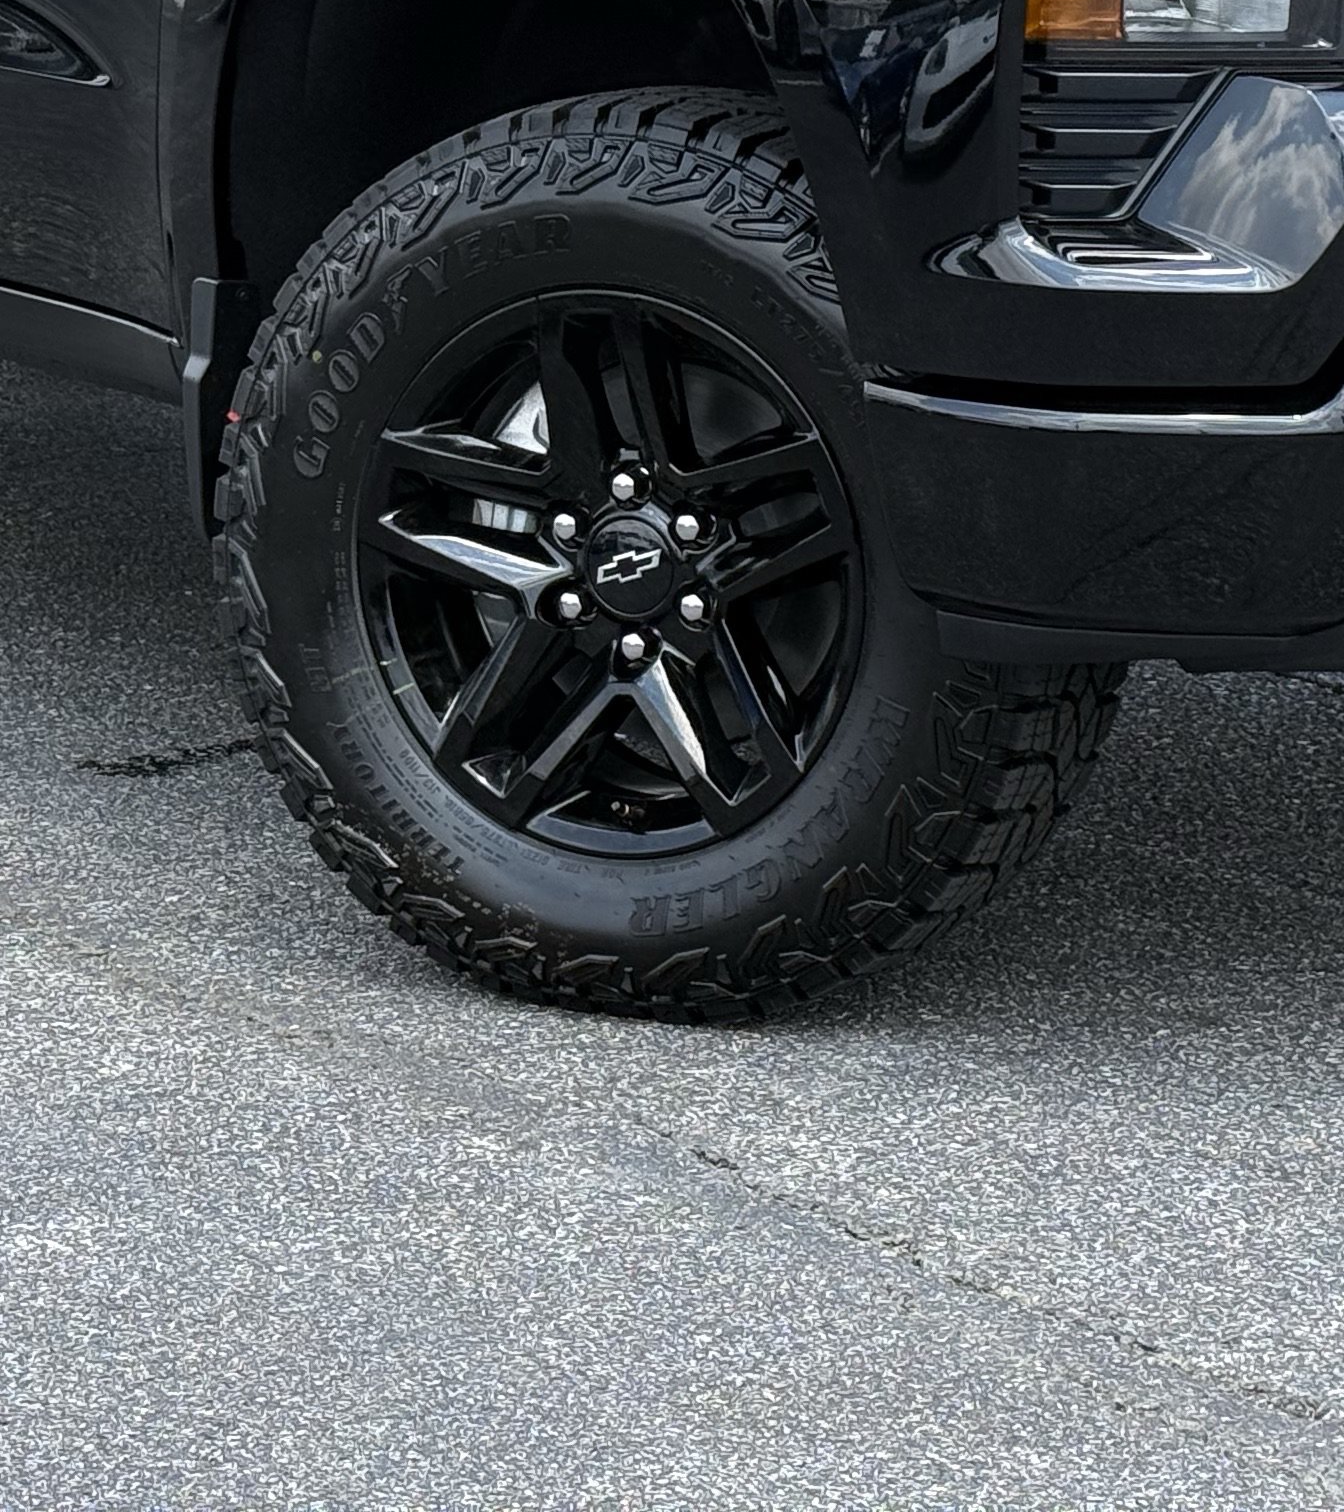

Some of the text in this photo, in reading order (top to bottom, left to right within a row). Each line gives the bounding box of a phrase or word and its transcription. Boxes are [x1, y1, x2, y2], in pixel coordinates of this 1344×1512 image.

[293, 213, 572, 479] GOODYEAR
[324, 716, 465, 876] TERRITORY
[627, 694, 912, 937] WRANGLER
